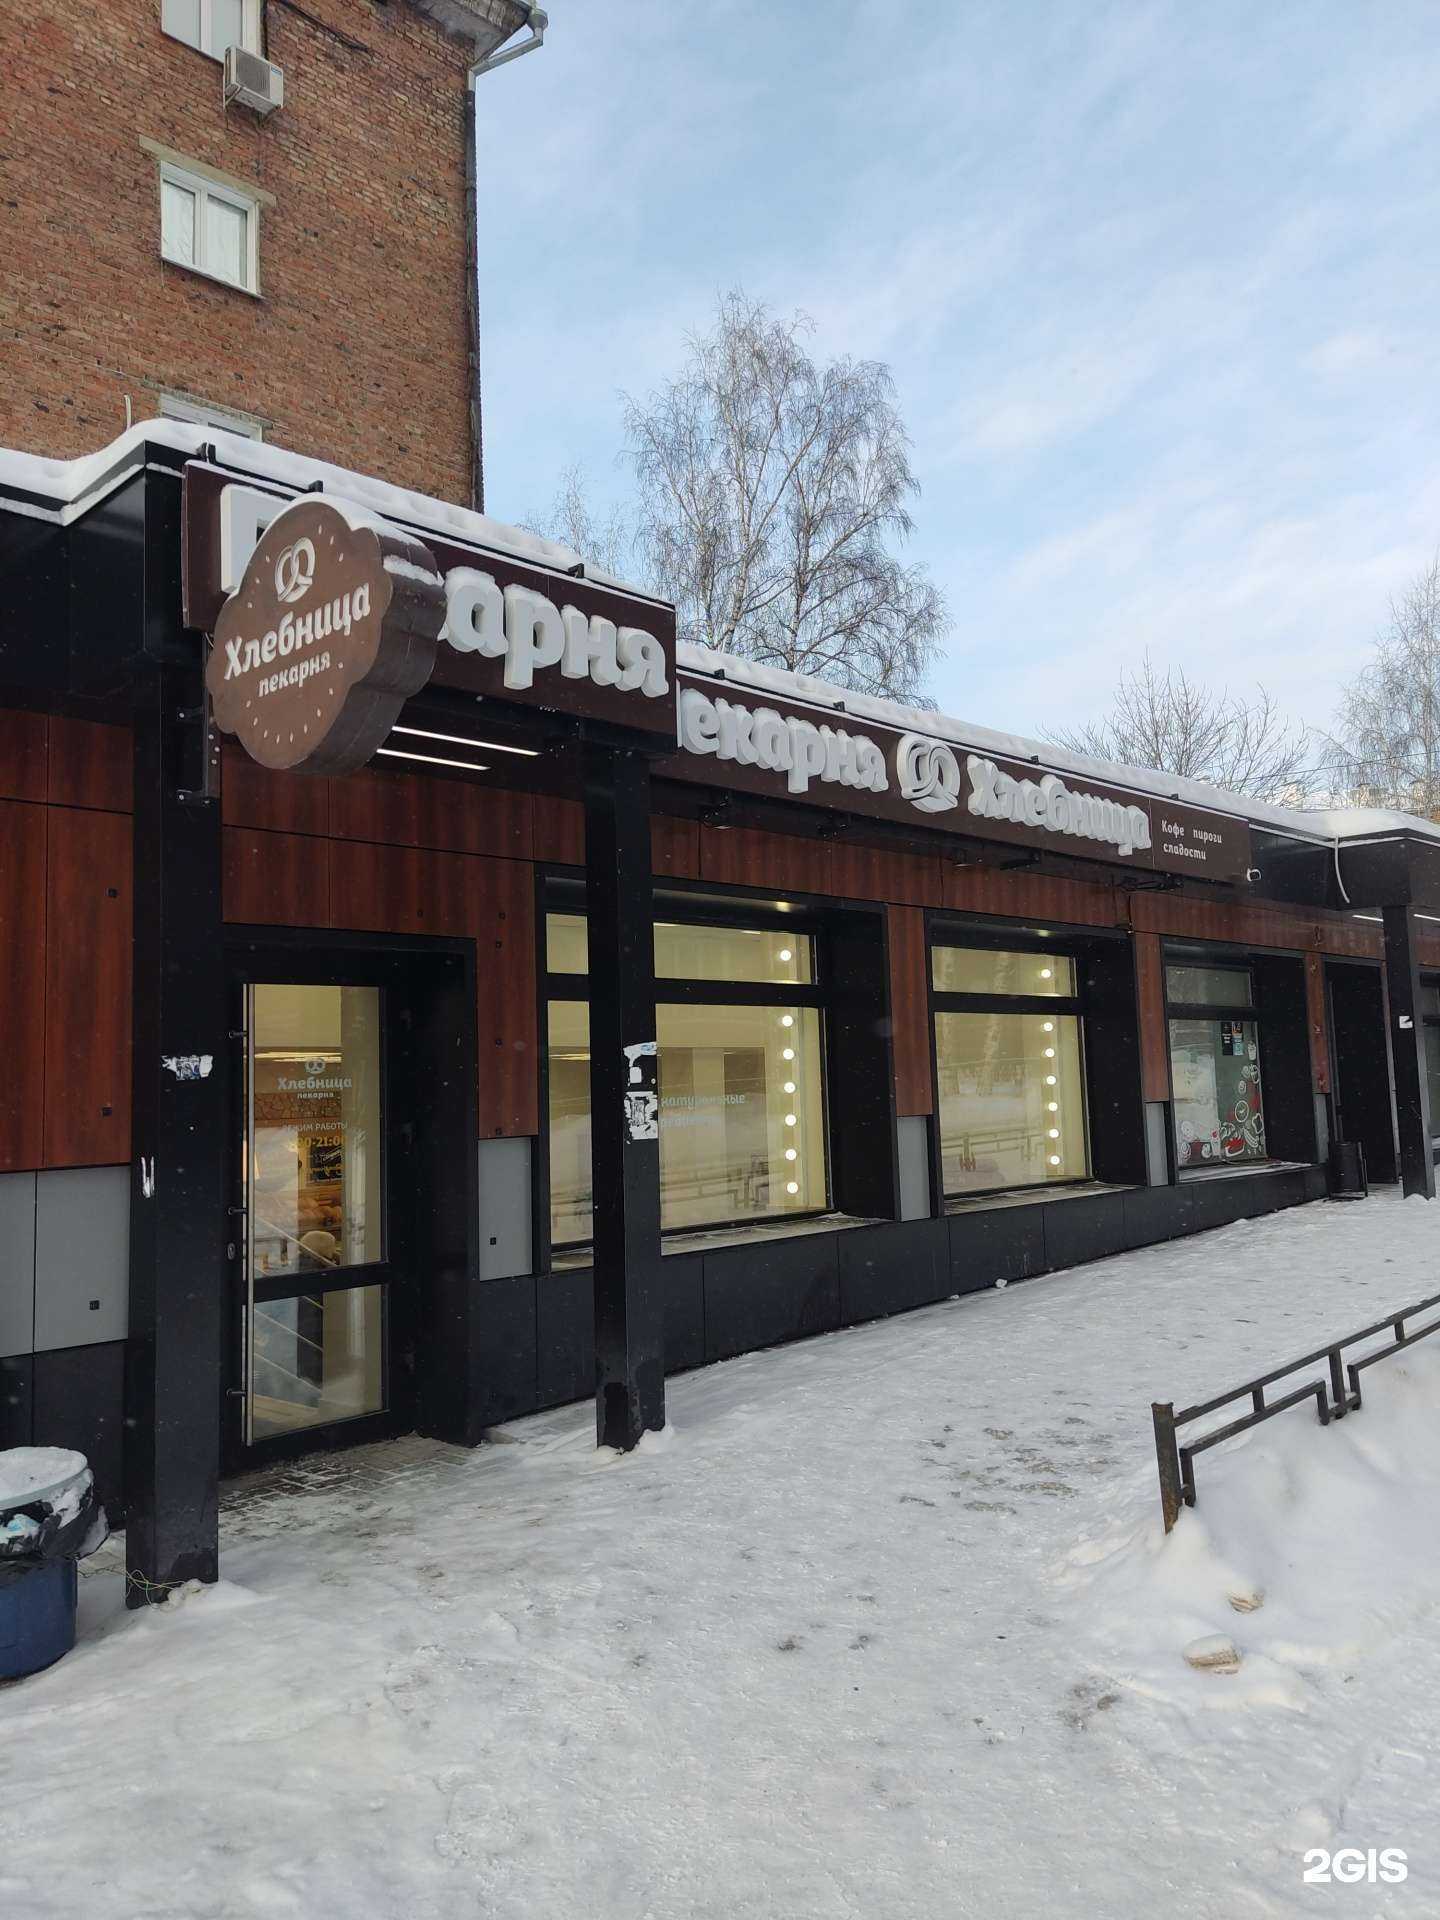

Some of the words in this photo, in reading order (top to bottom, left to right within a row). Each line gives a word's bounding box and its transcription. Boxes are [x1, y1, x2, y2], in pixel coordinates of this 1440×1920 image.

[224, 583, 370, 680] Хлебница
[258, 651, 331, 697] пекарня
[676, 679, 889, 794] екарня
[967, 754, 1151, 856] Хлебница
[1161, 819, 1185, 838] Кофе
[1193, 828, 1222, 844] пироги
[1163, 843, 1206, 860] сладости
[277, 1076, 352, 1090] Хлебница
